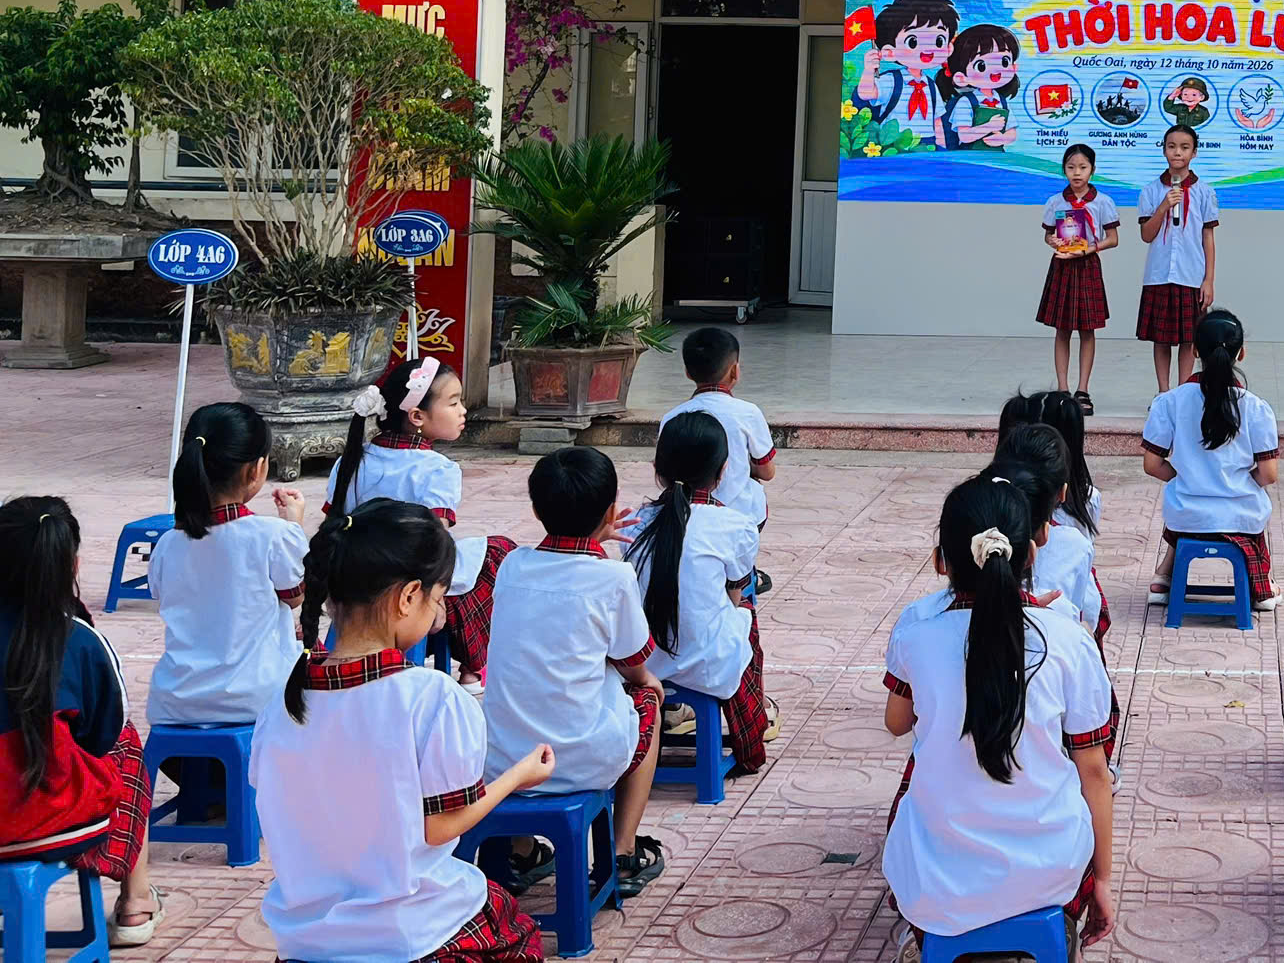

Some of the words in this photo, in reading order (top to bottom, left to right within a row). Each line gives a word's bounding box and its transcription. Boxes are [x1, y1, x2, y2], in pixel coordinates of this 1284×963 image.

[1144, 2, 1237, 44] HOA
[1072, 55, 1101, 68] Quốc
[1104, 57, 1126, 68] Oai,
[1130, 58, 1157, 70] ngày
[1160, 58, 1172, 68] 12
[1174, 59, 1204, 71] tháng
[1207, 59, 1219, 69] 10
[1221, 59, 1244, 70] năm
[1247, 60, 1274, 71] 2026
[1036, 128, 1049, 137] TÌM
[1114, 131, 1128, 139] ANH
[1036, 138, 1056, 147] LỊCH
[1102, 139, 1118, 147] DÂN
[1120, 139, 1136, 149] TỘC
[1240, 142, 1257, 150] HÔM
[1258, 143, 1274, 151] NAY
[381, 225, 407, 243] LỚP
[410, 228, 433, 243] 3A6
[158, 239, 192, 263] LỚP
[196, 245, 225, 264] 4A6
